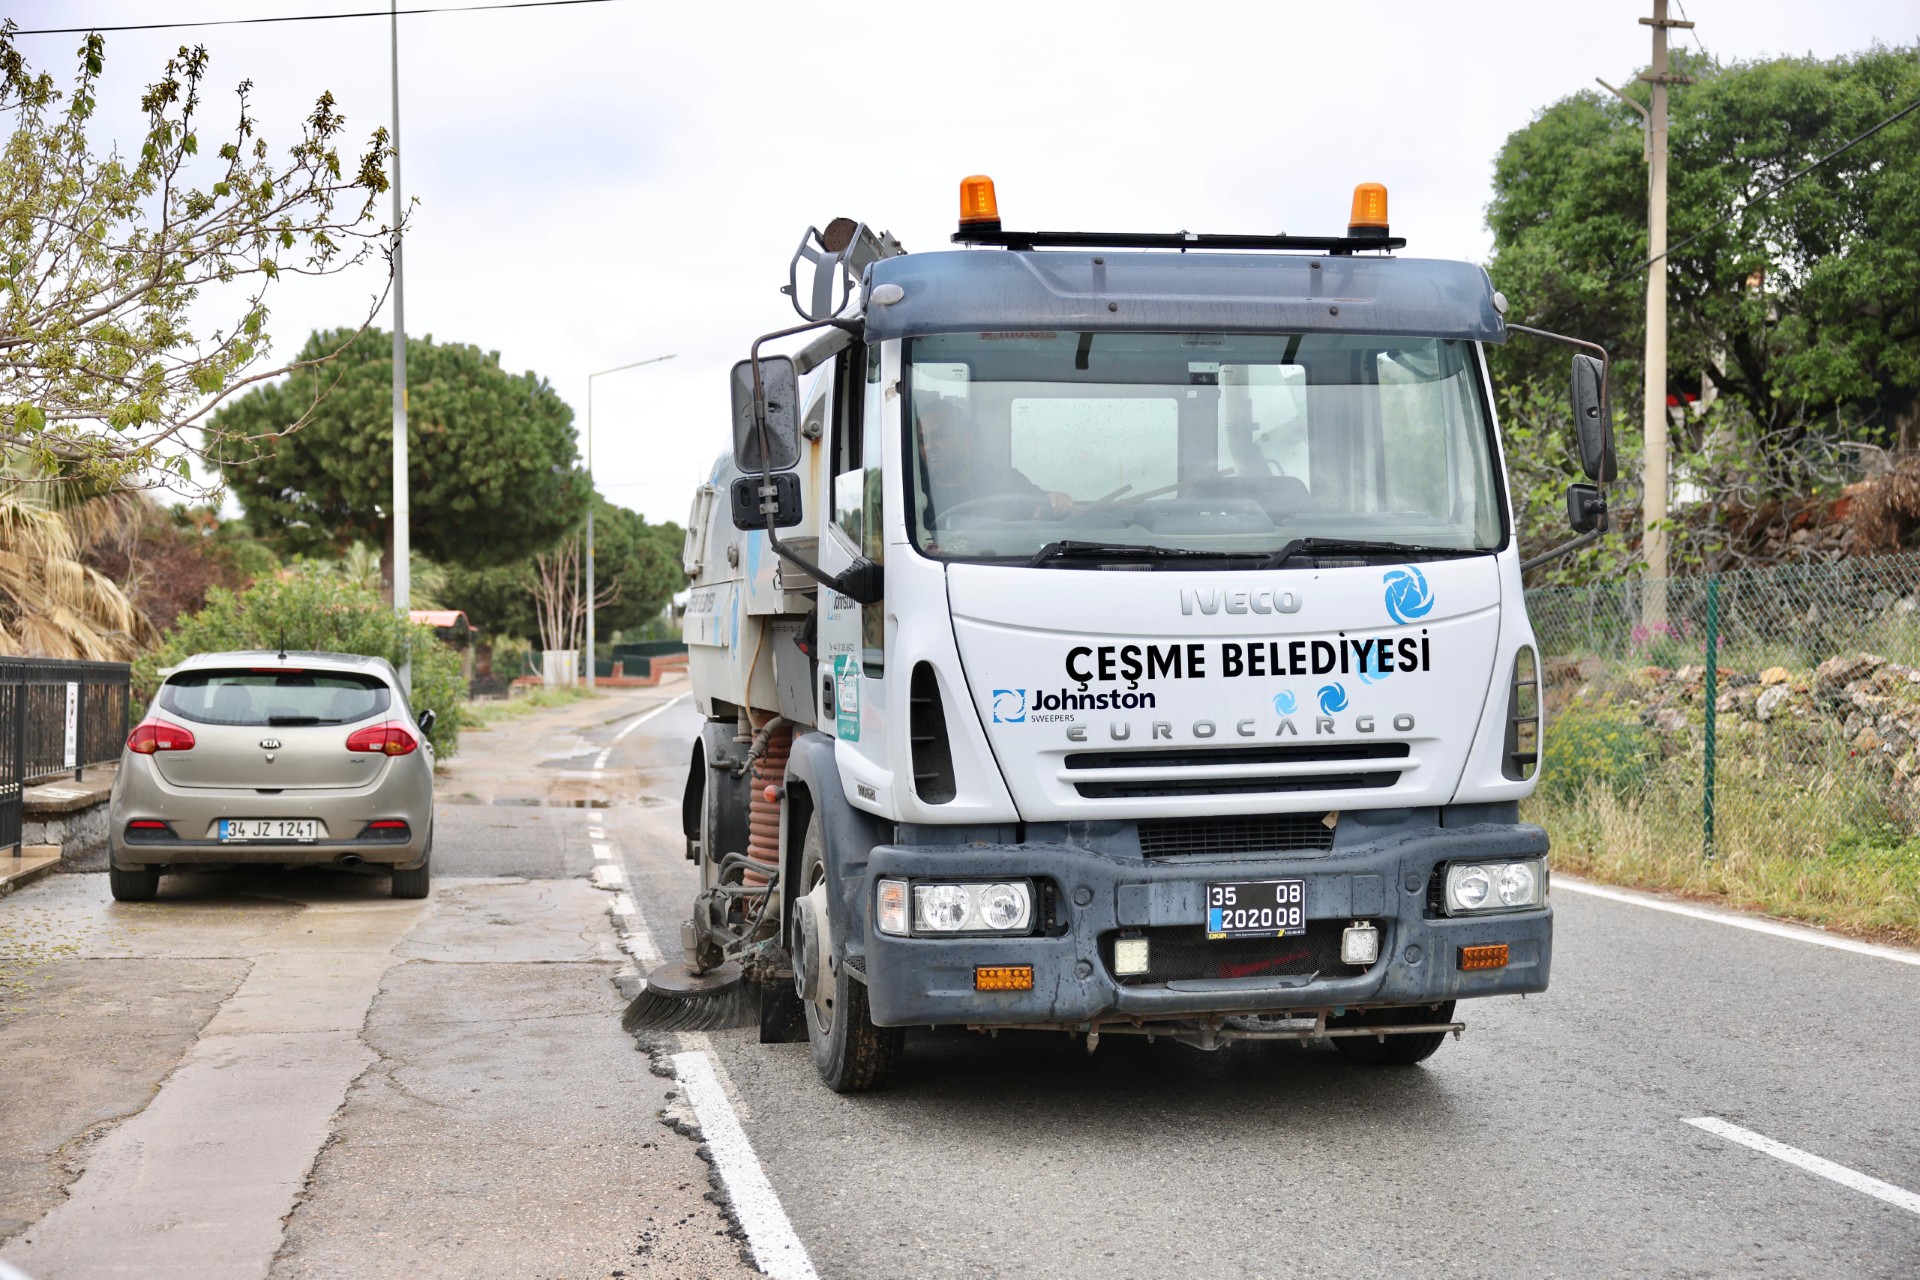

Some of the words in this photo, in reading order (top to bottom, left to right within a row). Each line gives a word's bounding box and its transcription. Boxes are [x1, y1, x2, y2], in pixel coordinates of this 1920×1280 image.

[1180, 587, 1302, 615] IVECO
[1065, 644, 1206, 692] ÇEŞME
[1222, 628, 1430, 677] BELEDİYESİ
[1031, 688, 1156, 711] Johnston
[1031, 714, 1075, 723] SWEEPERS
[1066, 713, 1415, 742] EUROCARGO
[262, 740, 279, 748] KIA
[228, 822, 246, 837] 34
[252, 822, 271, 837] JZ
[278, 822, 313, 837] 1241
[1212, 887, 1237, 906] 35
[1276, 884, 1301, 904] 08
